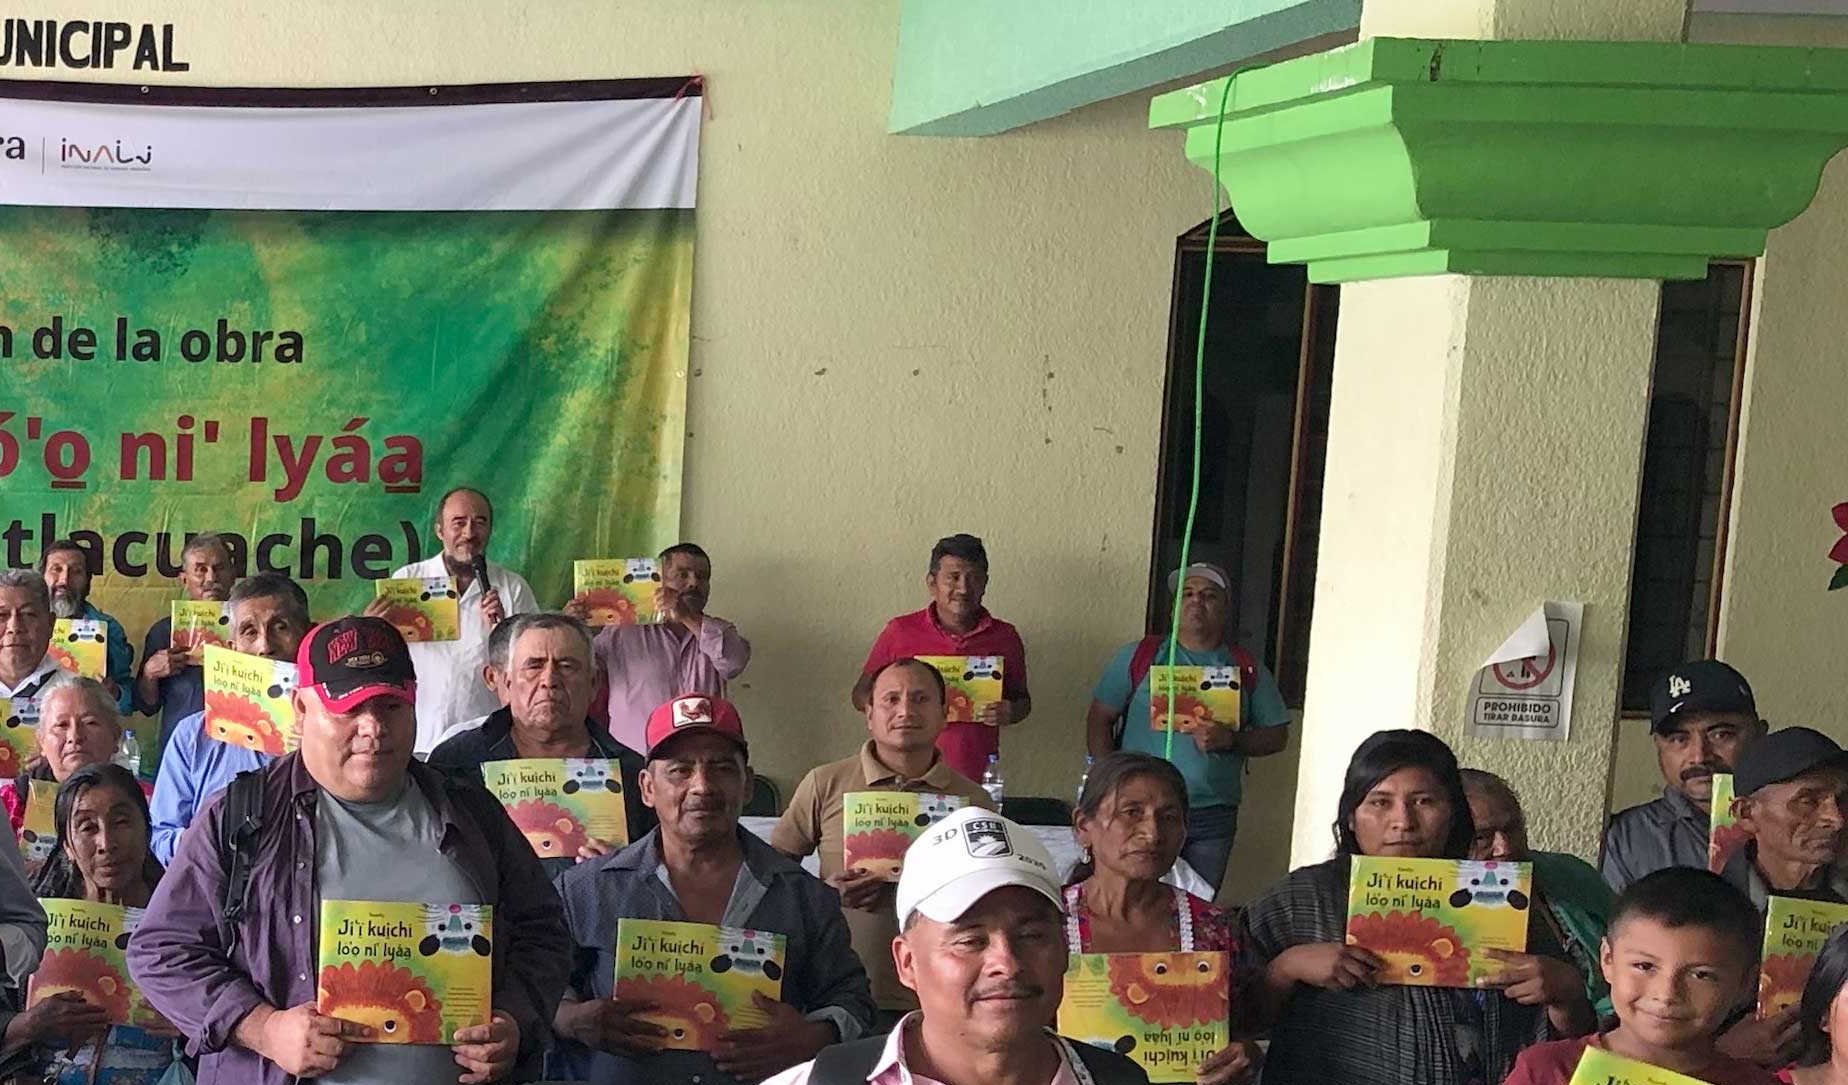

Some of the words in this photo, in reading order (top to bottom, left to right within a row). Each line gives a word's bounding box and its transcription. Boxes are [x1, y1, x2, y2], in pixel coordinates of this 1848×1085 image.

[32, 315, 104, 360] de
[117, 317, 161, 361] la
[181, 317, 305, 364] obra
[1484, 701, 1552, 714] PROHIBIDO
[1483, 712, 1510, 722] TIRAR
[1511, 713, 1551, 724] BASURA
